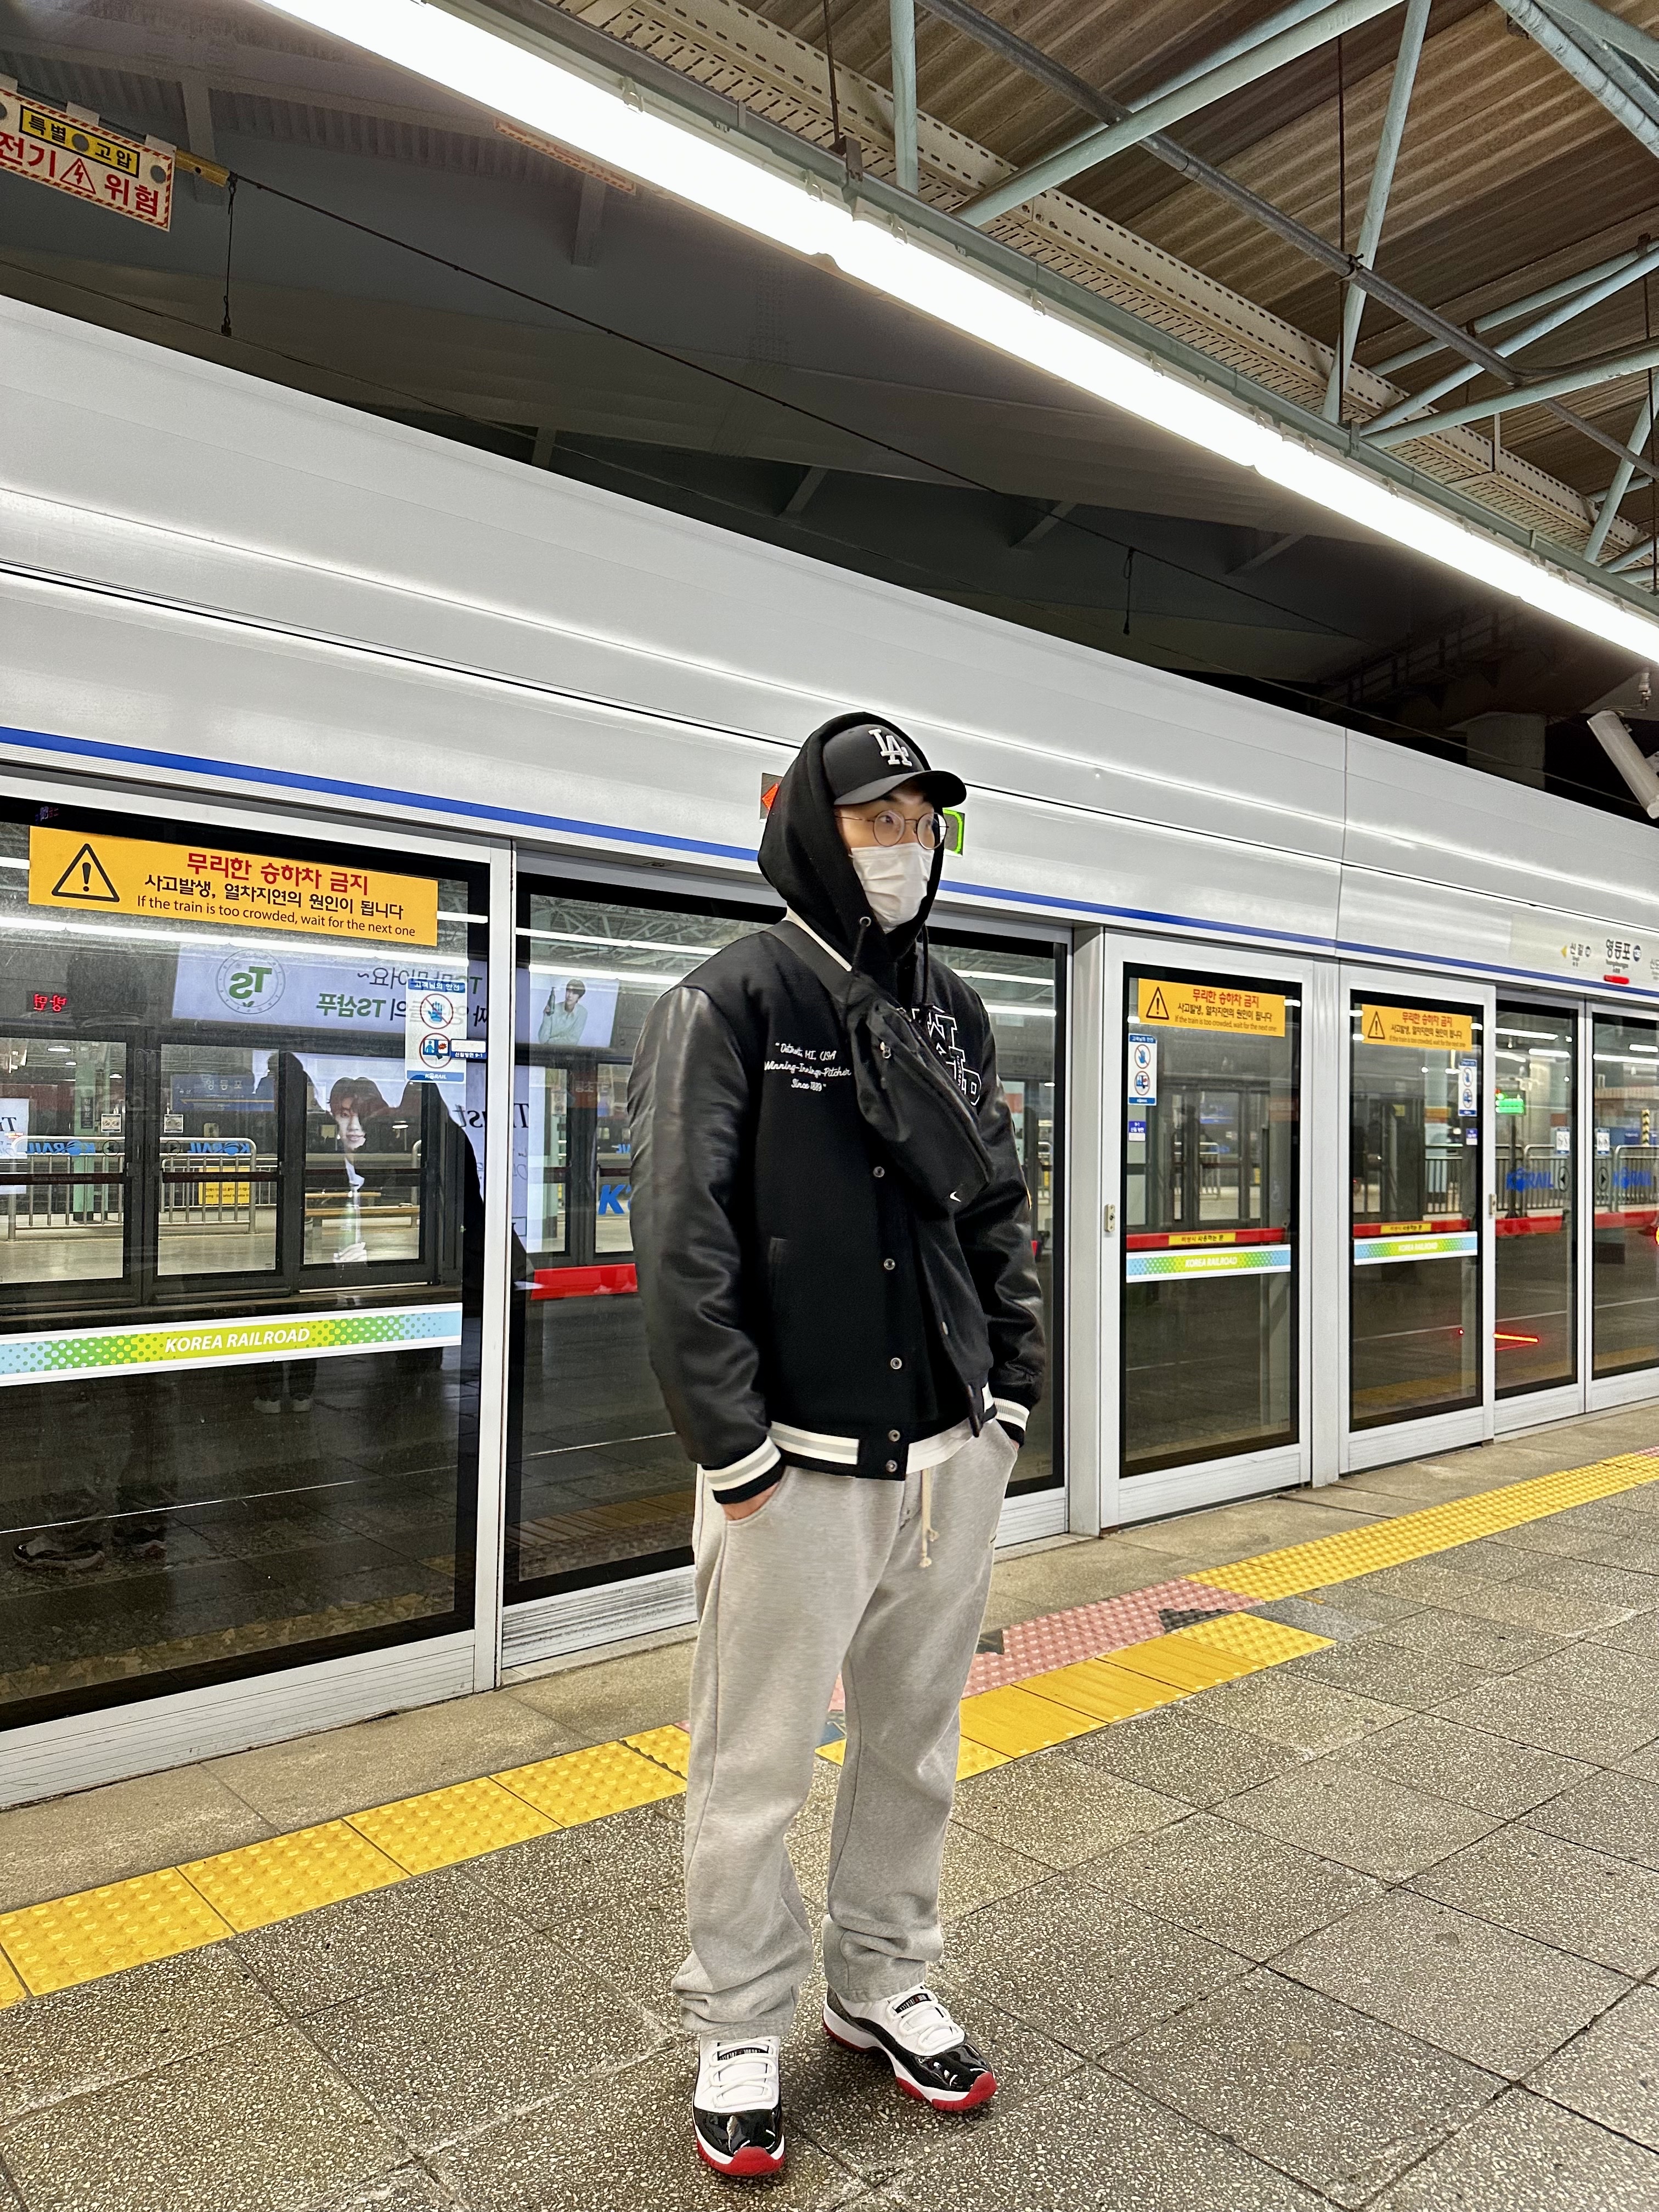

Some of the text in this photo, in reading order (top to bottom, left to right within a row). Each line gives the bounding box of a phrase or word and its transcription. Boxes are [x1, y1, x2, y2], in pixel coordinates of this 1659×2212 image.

[29, 114, 132, 170] 특별 고압
[0, 132, 159, 217] 전기 위험
[868, 728, 912, 767] LA
[187, 852, 368, 896] 무리한 승하차 금지
[144, 874, 404, 920] 사고발생, 열차지연의 원인이 됩니다
[137, 895, 416, 936] If the train is too crowded, wait for the next one
[1605, 939, 1631, 960] 영등포
[445, 983, 460, 991] 안전
[1193, 989, 1260, 1008] 무리한 승하차 금지
[820, 1050, 837, 1061] USA
[1185, 1256, 1238, 1268] KOREA RAILROAD
[165, 1328, 310, 1353] KOREA RAILROAD
